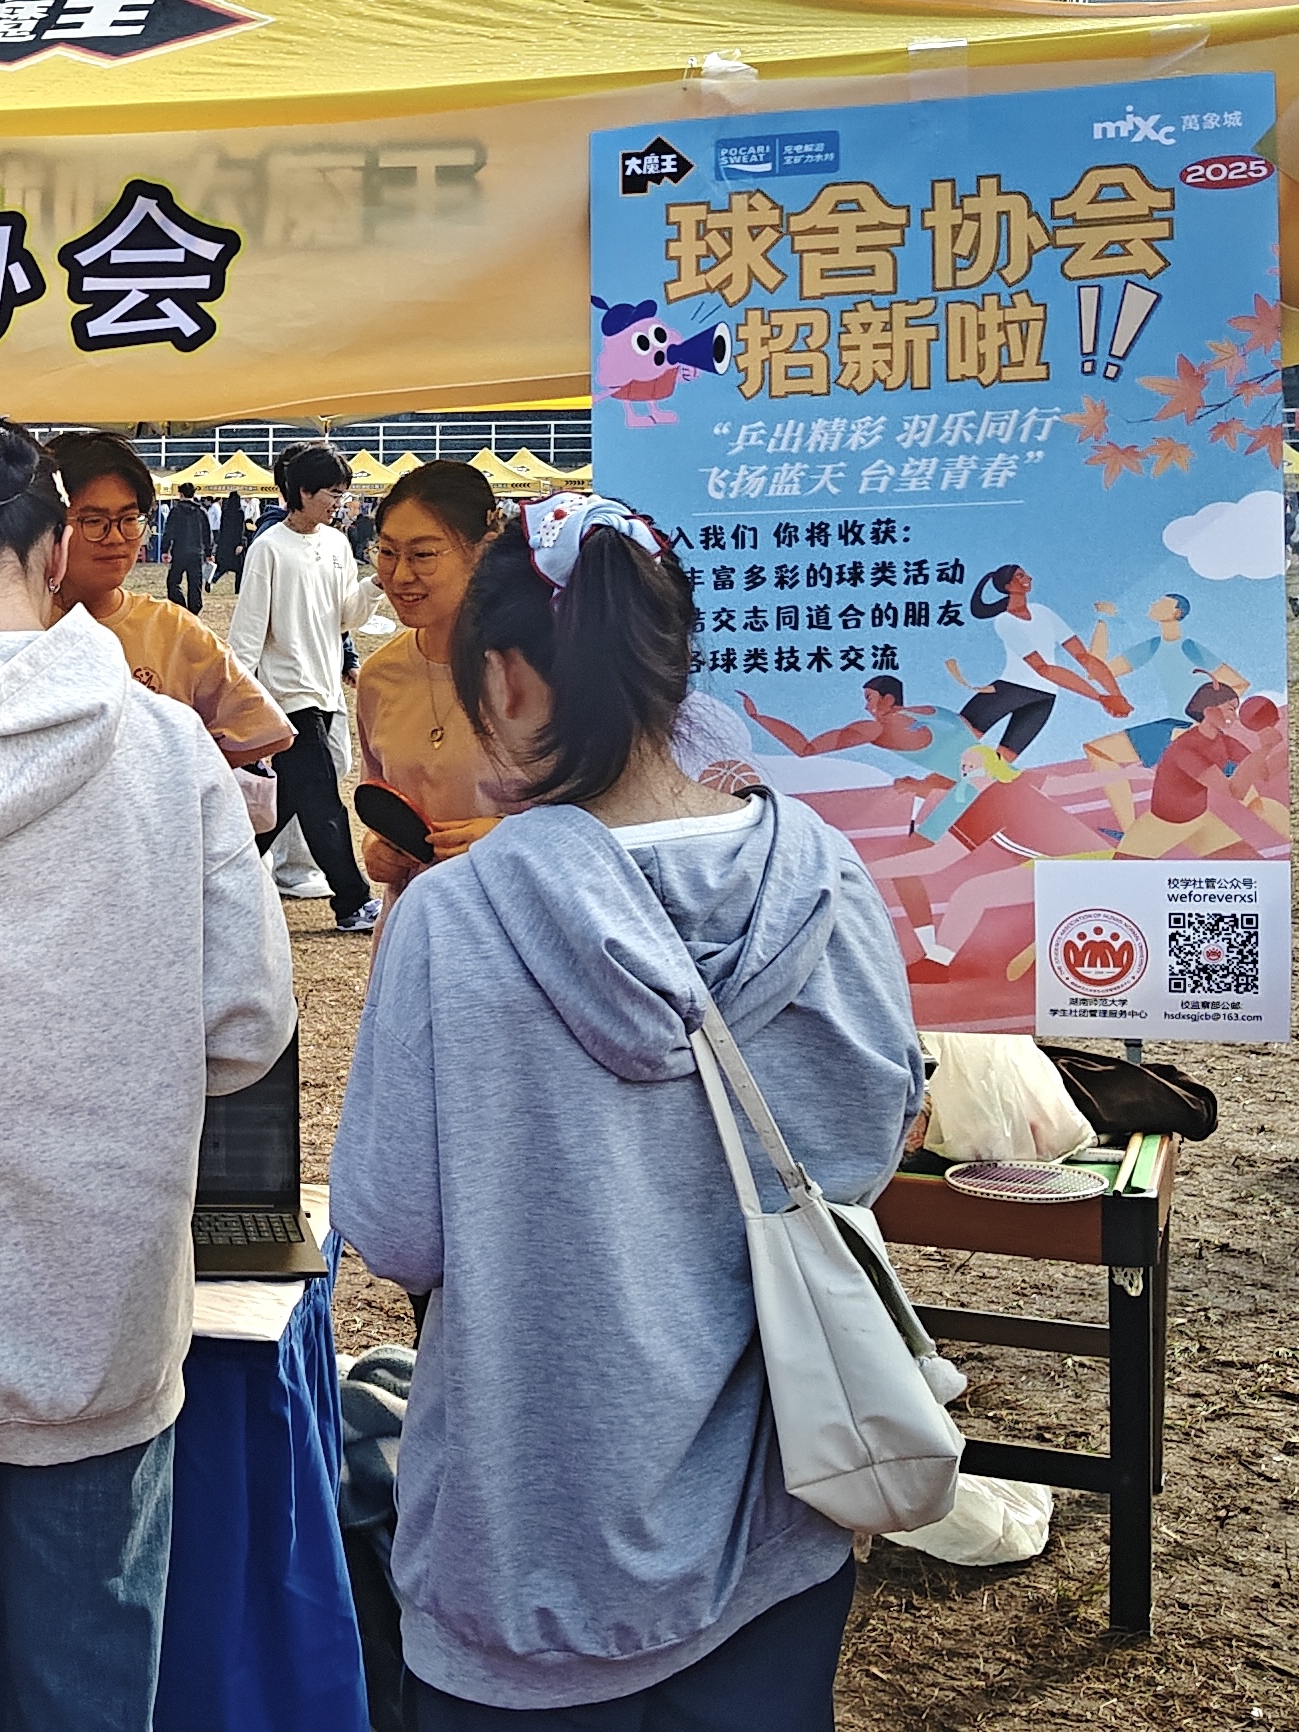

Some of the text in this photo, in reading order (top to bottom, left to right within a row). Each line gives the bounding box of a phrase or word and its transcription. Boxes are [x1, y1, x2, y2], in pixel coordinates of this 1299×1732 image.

[1180, 110, 1243, 132] 萬象城
[720, 144, 771, 157] POCARI
[720, 153, 765, 165] SWEAT
[624, 153, 679, 176] 大魔王
[1185, 160, 1269, 184] 2025
[664, 164, 1175, 306] 球舍协会
[712, 406, 1062, 456] “乒出精彩 羽乐同行
[698, 450, 1045, 499] 飞扬蓝天 台望青春”
[772, 518, 911, 549] 你将收获:
[685, 558, 965, 592] 丰富多彩的球类活动
[1166, 889, 1258, 904] weforeverxsl
